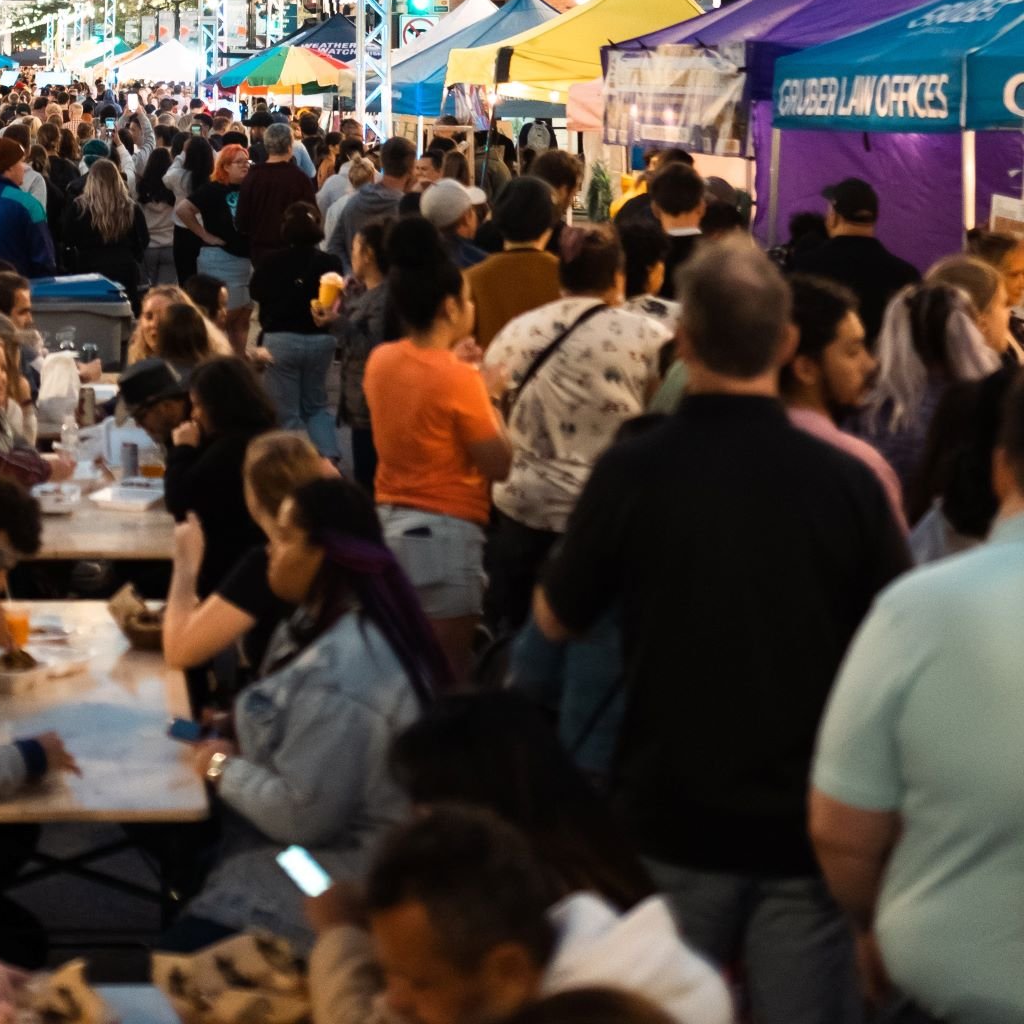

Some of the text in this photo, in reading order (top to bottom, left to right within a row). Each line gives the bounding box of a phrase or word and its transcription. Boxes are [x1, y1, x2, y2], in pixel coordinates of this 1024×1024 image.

[778, 74, 949, 119] GRUBER LAW OFFICES
